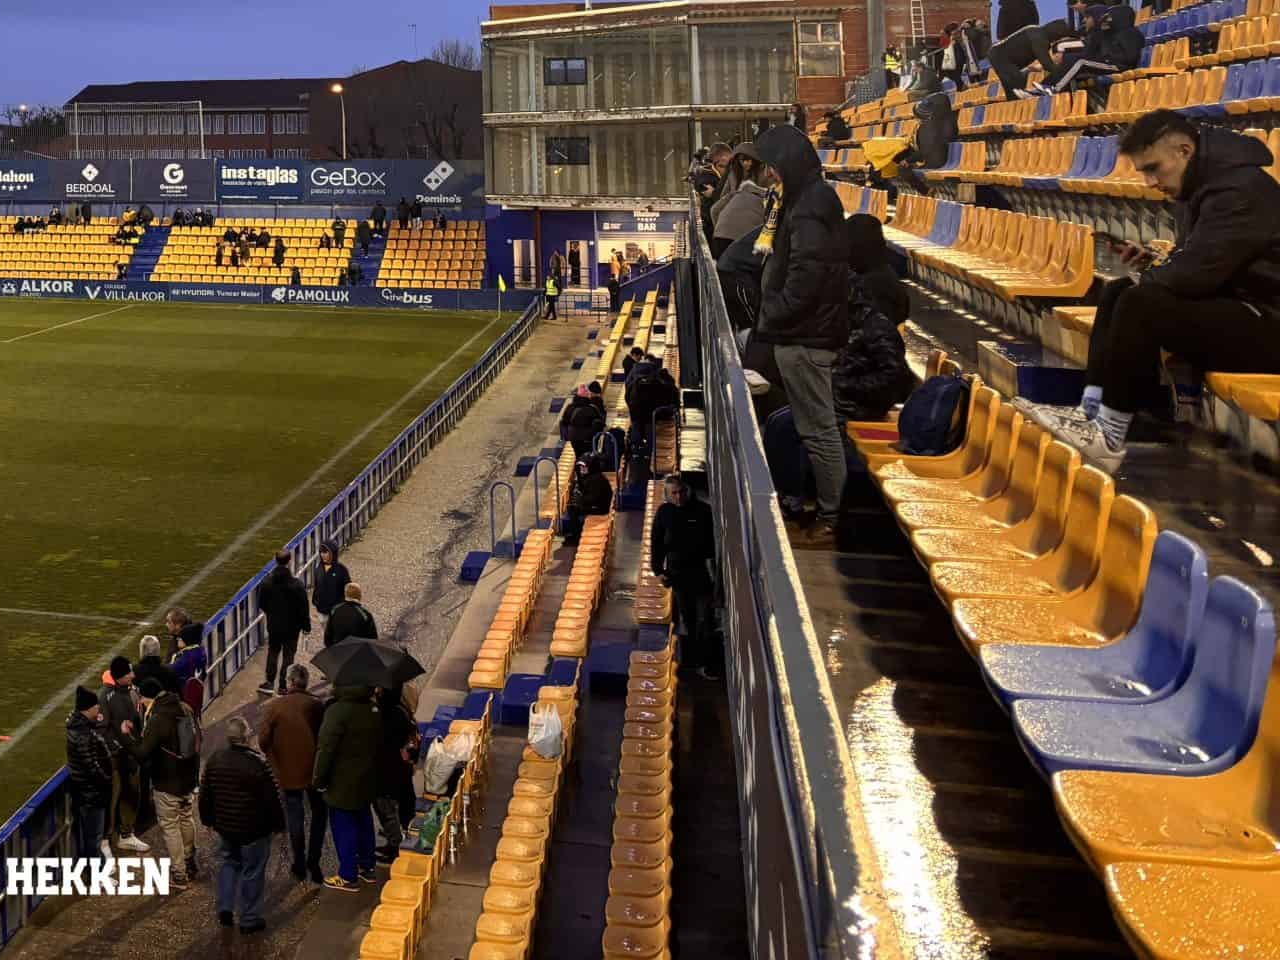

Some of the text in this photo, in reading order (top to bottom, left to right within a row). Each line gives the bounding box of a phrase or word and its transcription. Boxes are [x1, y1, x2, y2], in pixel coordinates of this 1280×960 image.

[221, 166, 298, 186] instaglas
[311, 167, 386, 186] GeBox
[66, 183, 115, 193] BERDOAL
[416, 194, 462, 204] Domino's
[637, 223, 657, 231] BAR
[20, 280, 74, 293] ALKOR
[104, 289, 165, 302] VILLALKOR
[289, 289, 350, 303] PAMOLUX
